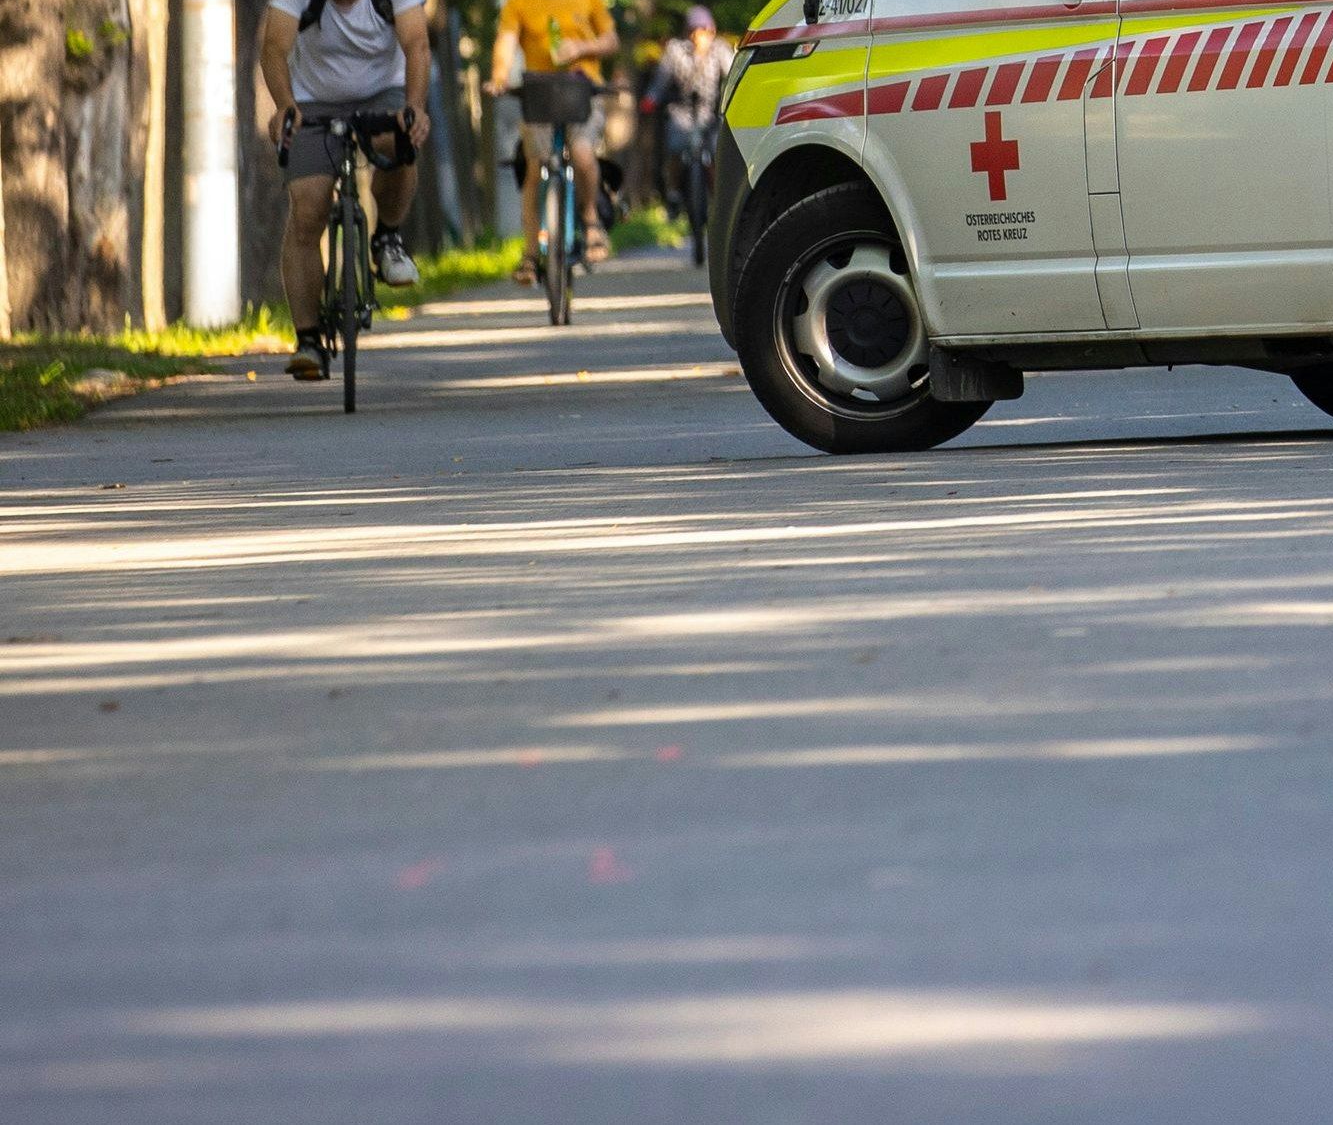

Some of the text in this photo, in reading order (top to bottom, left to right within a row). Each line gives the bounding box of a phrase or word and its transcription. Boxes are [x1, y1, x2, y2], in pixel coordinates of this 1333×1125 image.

[965, 211, 1036, 227] ÖSTERREICHISCHES
[977, 228, 1028, 242] ROTES KREUZ
